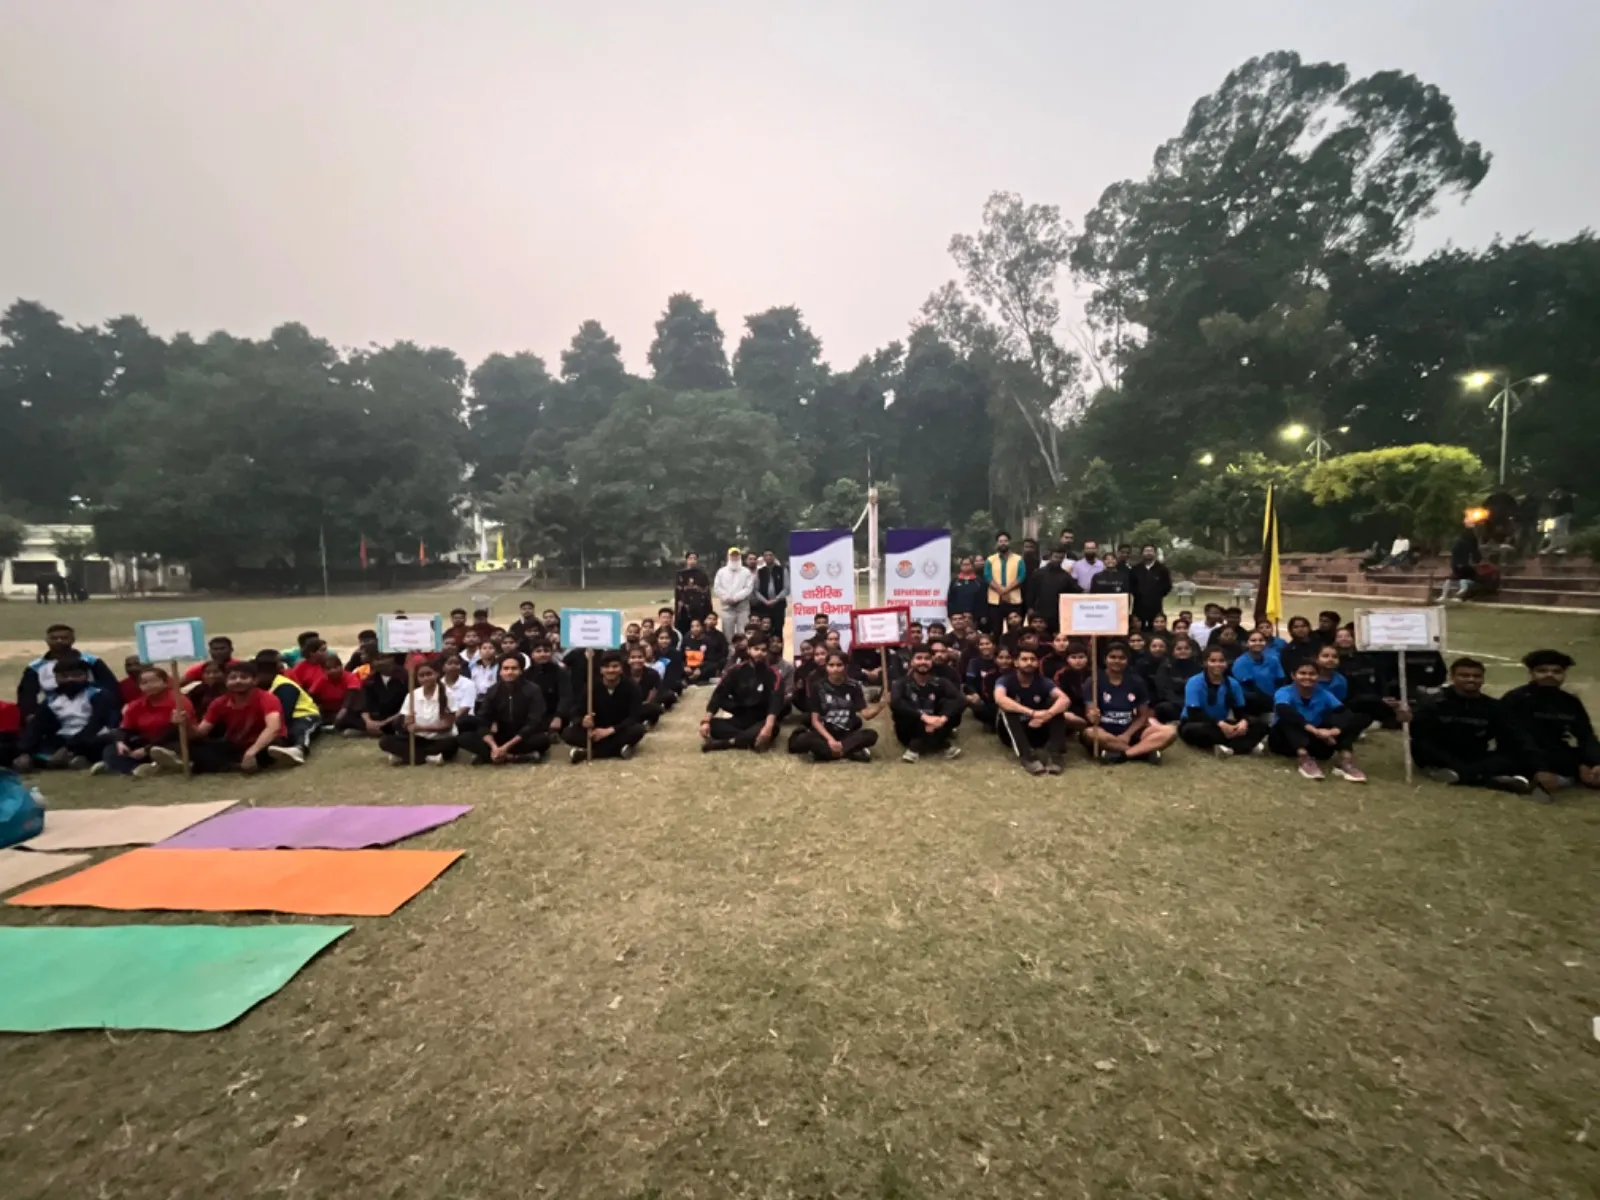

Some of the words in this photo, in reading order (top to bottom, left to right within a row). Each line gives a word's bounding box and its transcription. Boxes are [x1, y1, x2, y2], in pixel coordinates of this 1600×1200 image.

[802, 585, 843, 599] शारीरिक
[893, 588, 931, 596] DEPARTMENT
[933, 588, 941, 596] OF
